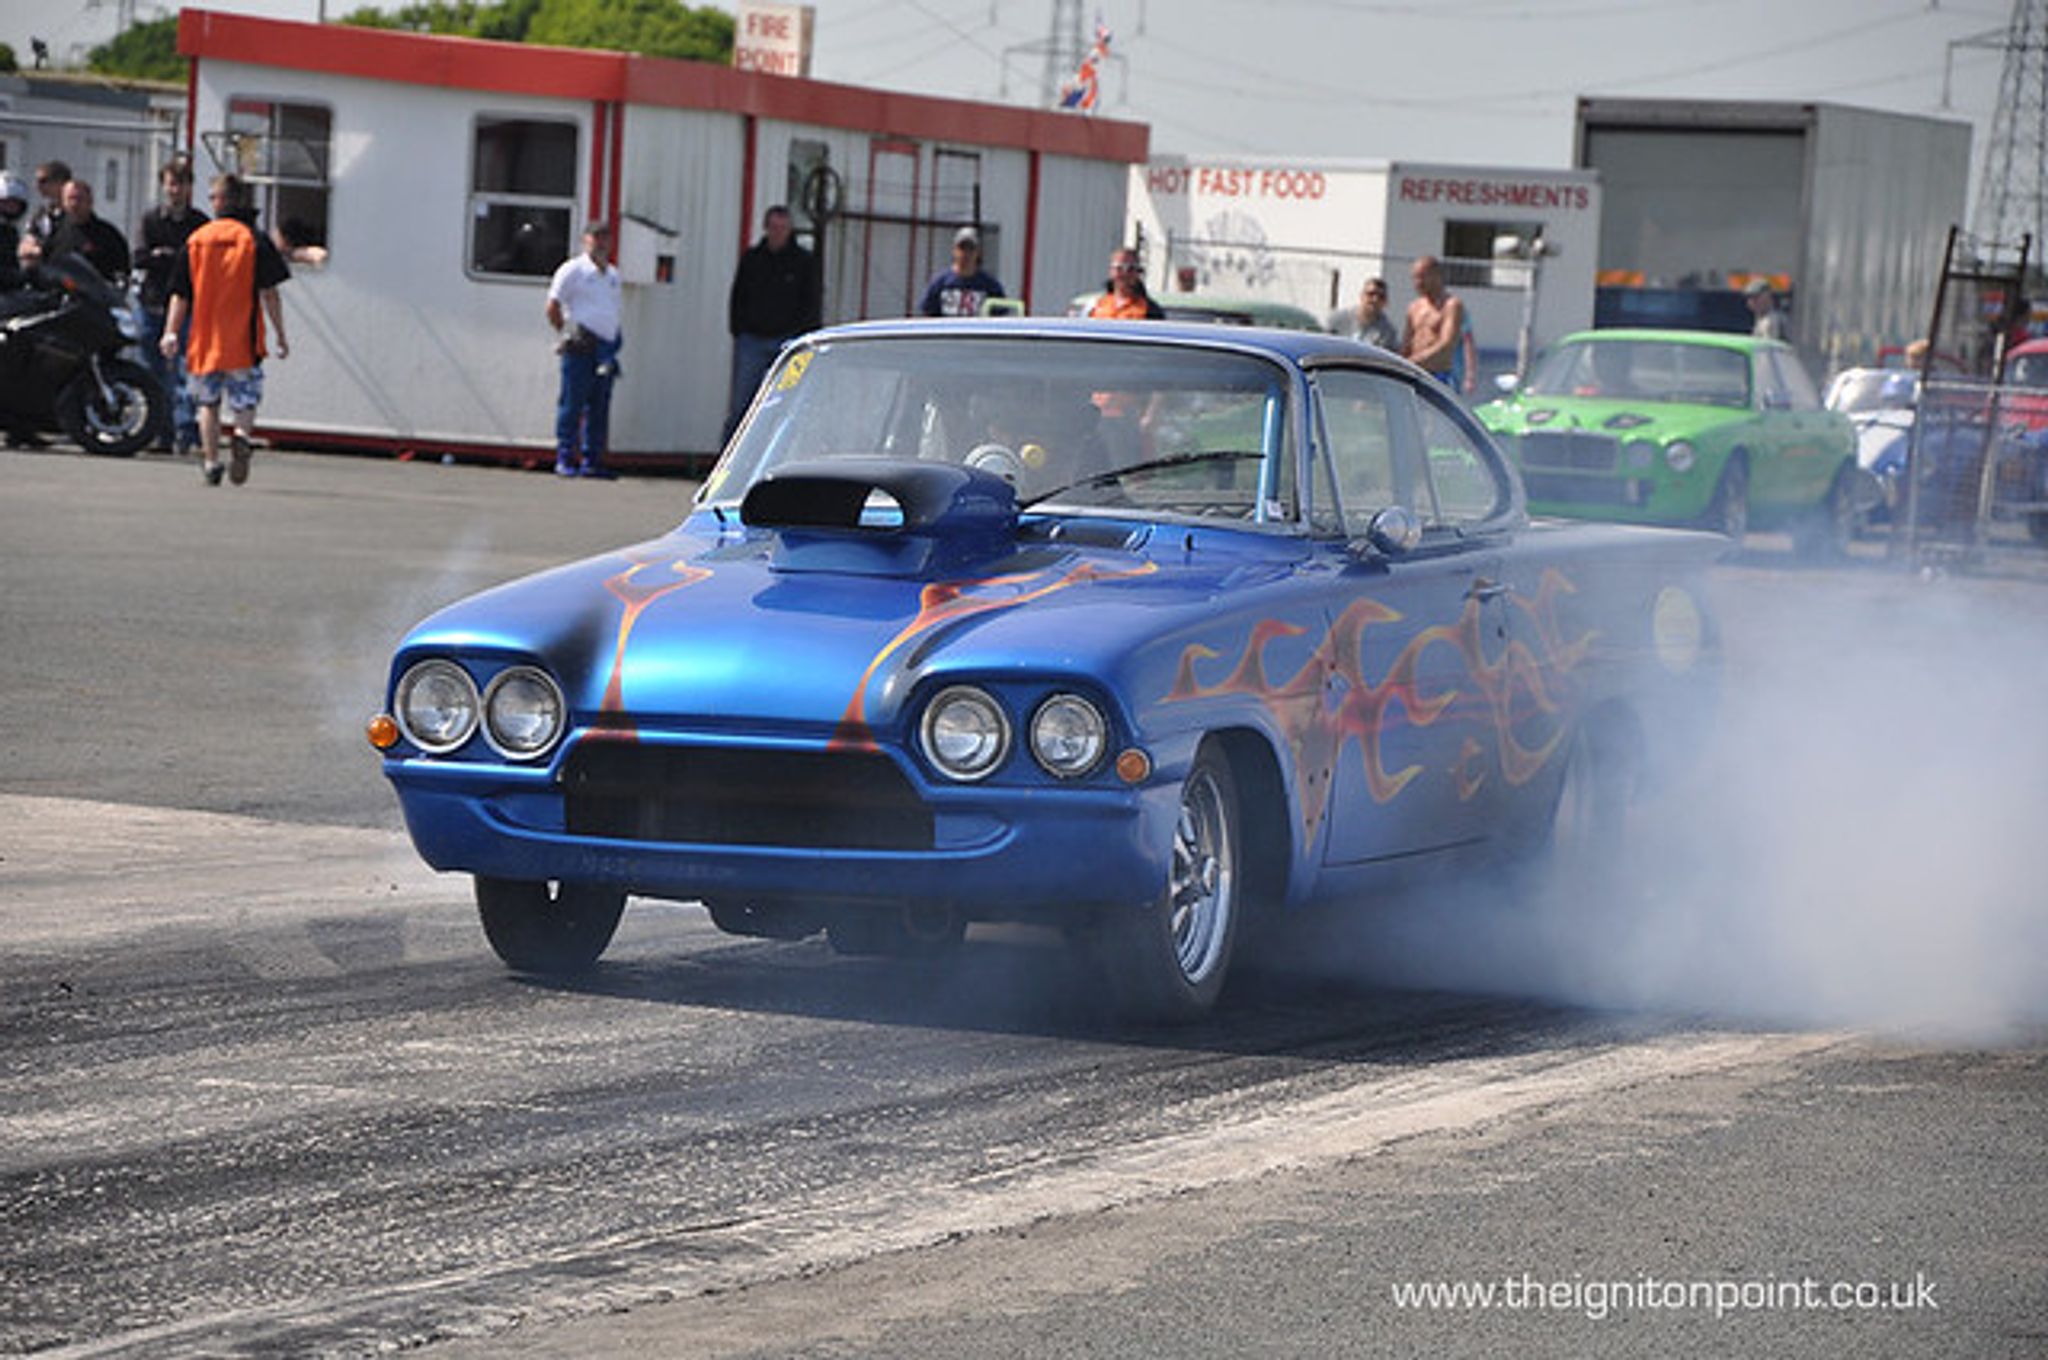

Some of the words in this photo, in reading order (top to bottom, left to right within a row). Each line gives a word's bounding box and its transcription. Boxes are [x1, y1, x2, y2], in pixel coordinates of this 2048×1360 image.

[748, 14, 791, 39] FIRE
[737, 49, 797, 75] POINT
[1148, 168, 1191, 193] HOT
[1199, 168, 1253, 196] FAST
[1261, 170, 1326, 199] FOOD
[1401, 178, 1589, 209] REFRESHMENTS
